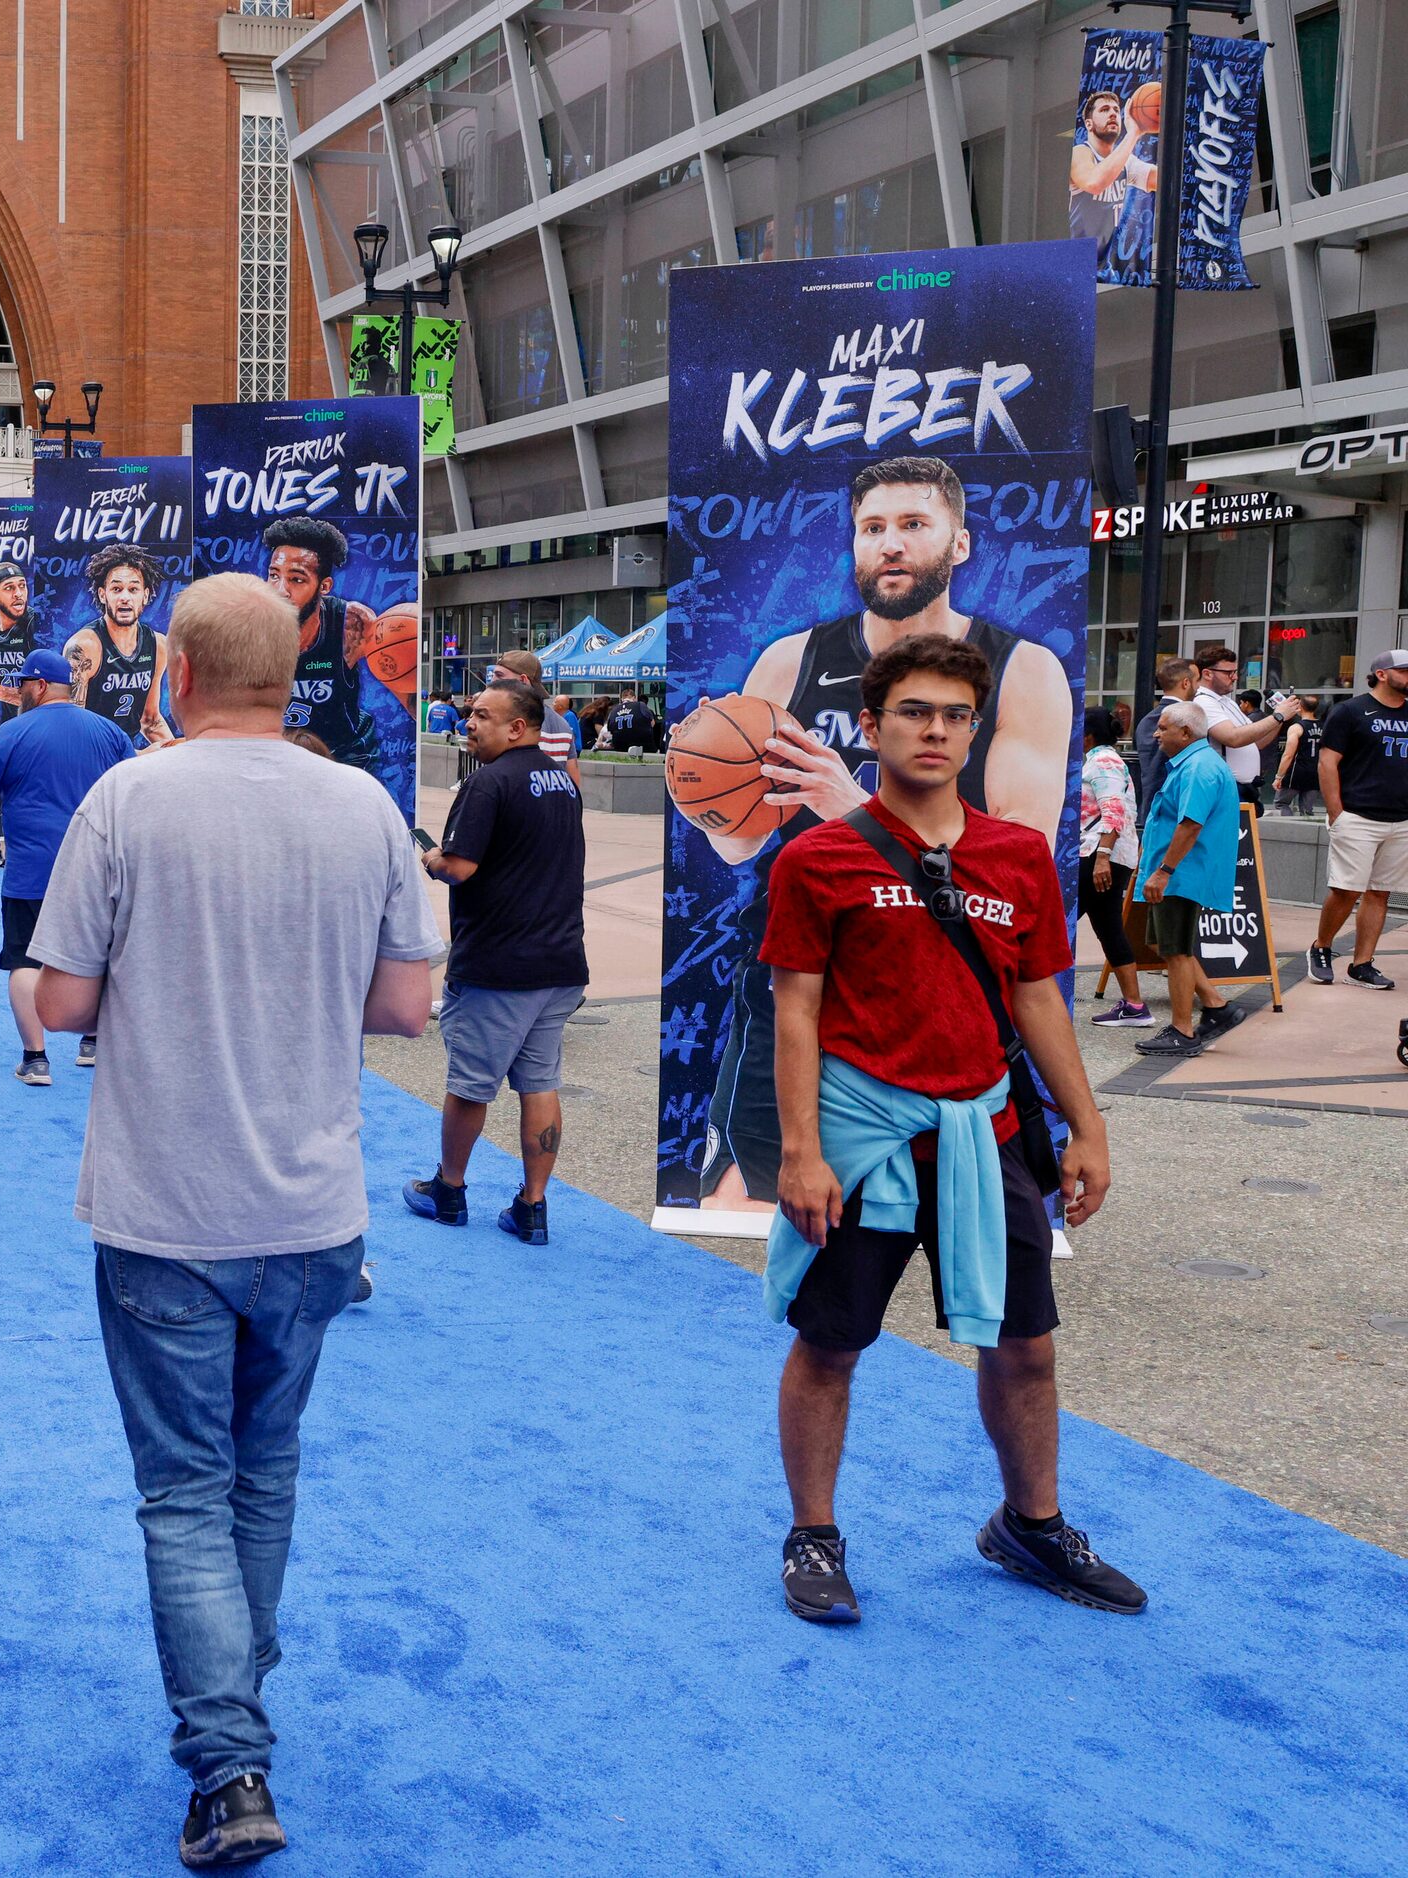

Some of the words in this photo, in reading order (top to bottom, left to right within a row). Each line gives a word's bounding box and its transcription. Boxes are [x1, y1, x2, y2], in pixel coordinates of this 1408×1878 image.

[1103, 36, 1121, 48] LUKA
[1188, 62, 1242, 249] PLAYOFFS
[802, 284, 831, 292] PLAYOFFS
[831, 282, 865, 290] PRESENTED
[876, 267, 951, 292] chime
[828, 318, 925, 373] MAXI
[304, 408, 344, 423] chime
[722, 361, 1034, 463] KLEBER
[264, 432, 347, 470] DERRICK
[118, 463, 148, 475] chime
[89, 482, 148, 508] DERECK
[204, 464, 341, 519] JONES
[354, 462, 410, 521] JR
[1211, 491, 1270, 510] LUXURY
[10, 503, 34, 512] chime
[1209, 505, 1294, 525] MENSWEAR
[54, 501, 158, 544] LIVELY
[159, 504, 183, 542] II
[1201, 600, 1221, 614] 103
[1281, 626, 1306, 641] open
[305, 661, 333, 670] chime
[559, 665, 586, 677] DALLAS
[588, 665, 634, 677] MAVERICKS
[101, 670, 153, 692] MAVS
[113, 693, 135, 717] 2
[282, 701, 313, 728] 5
[615, 714, 634, 730] 77
[1382, 735, 1408, 758] 77
[529, 769, 577, 798] MAVS
[871, 885, 1014, 927] HIIGER
[1198, 912, 1259, 938] HOTOS
